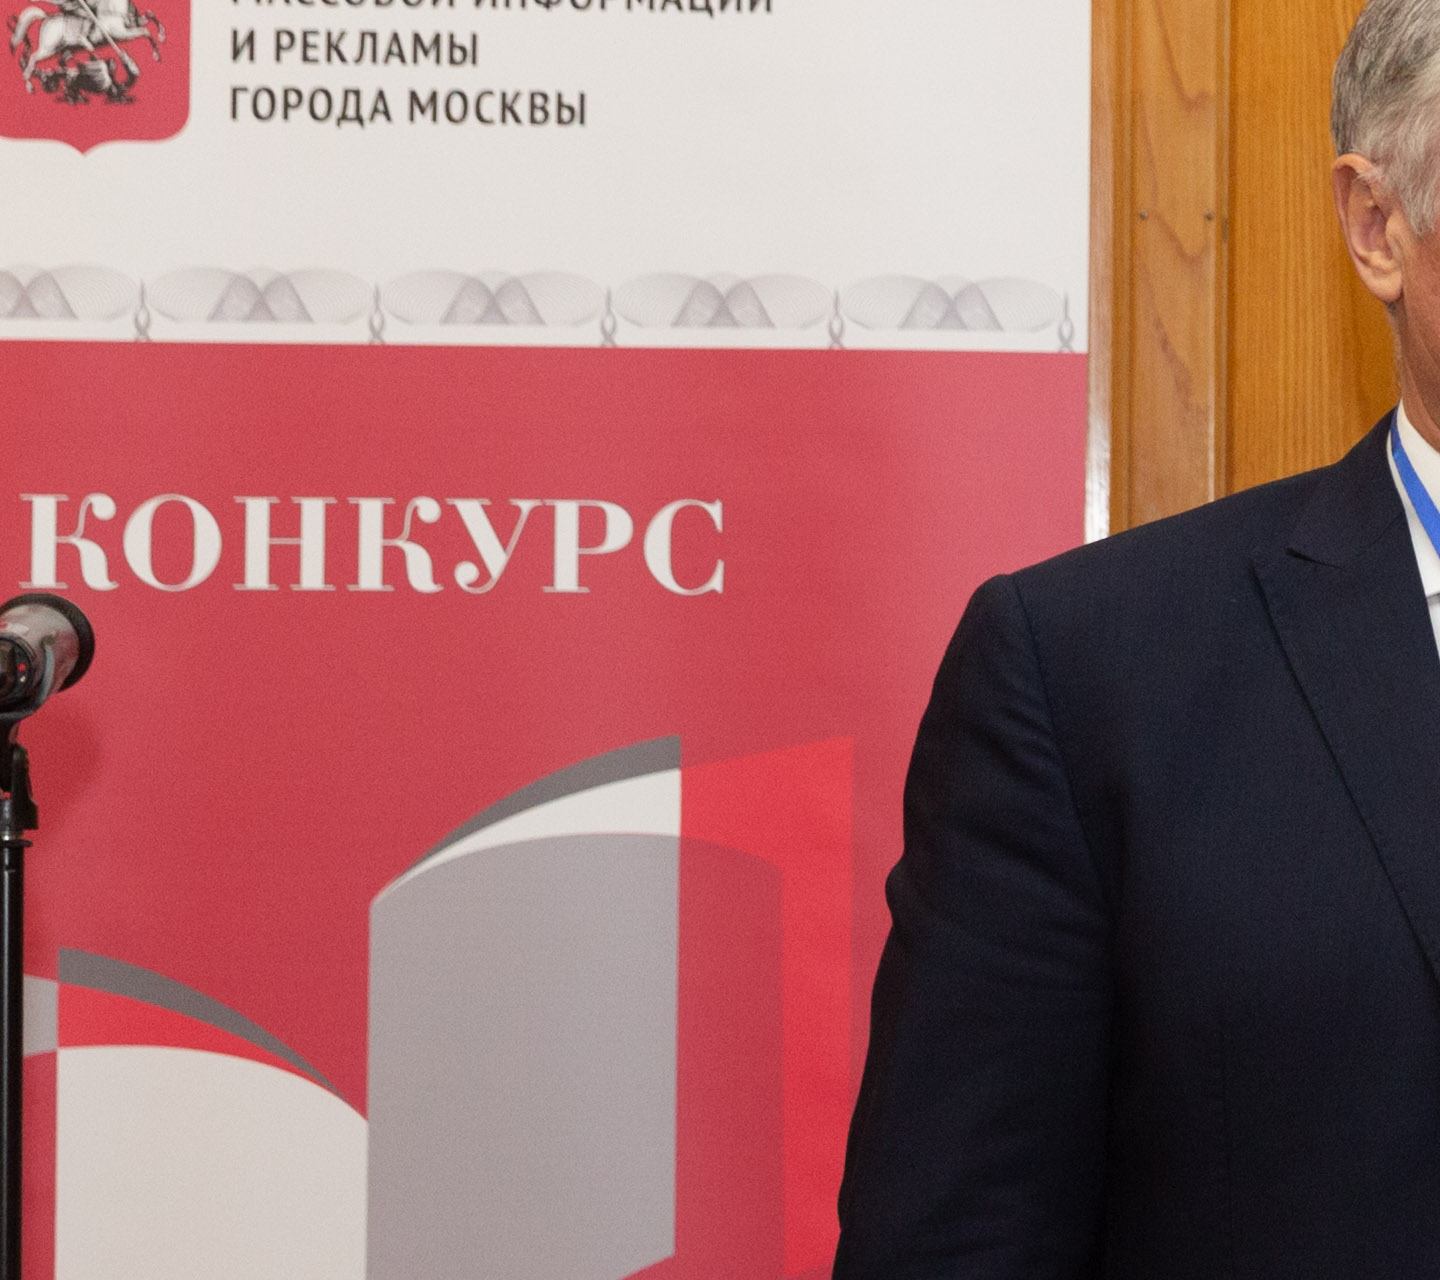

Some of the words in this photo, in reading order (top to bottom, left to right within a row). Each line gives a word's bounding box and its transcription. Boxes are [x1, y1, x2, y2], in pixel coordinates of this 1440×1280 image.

[231, 29, 256, 63] И
[274, 29, 479, 67] РЕКЛАМЫ
[230, 85, 393, 128] ГОРОДА
[408, 89, 587, 126] МОСКВЫ
[20, 492, 725, 597] КОНКУРС
